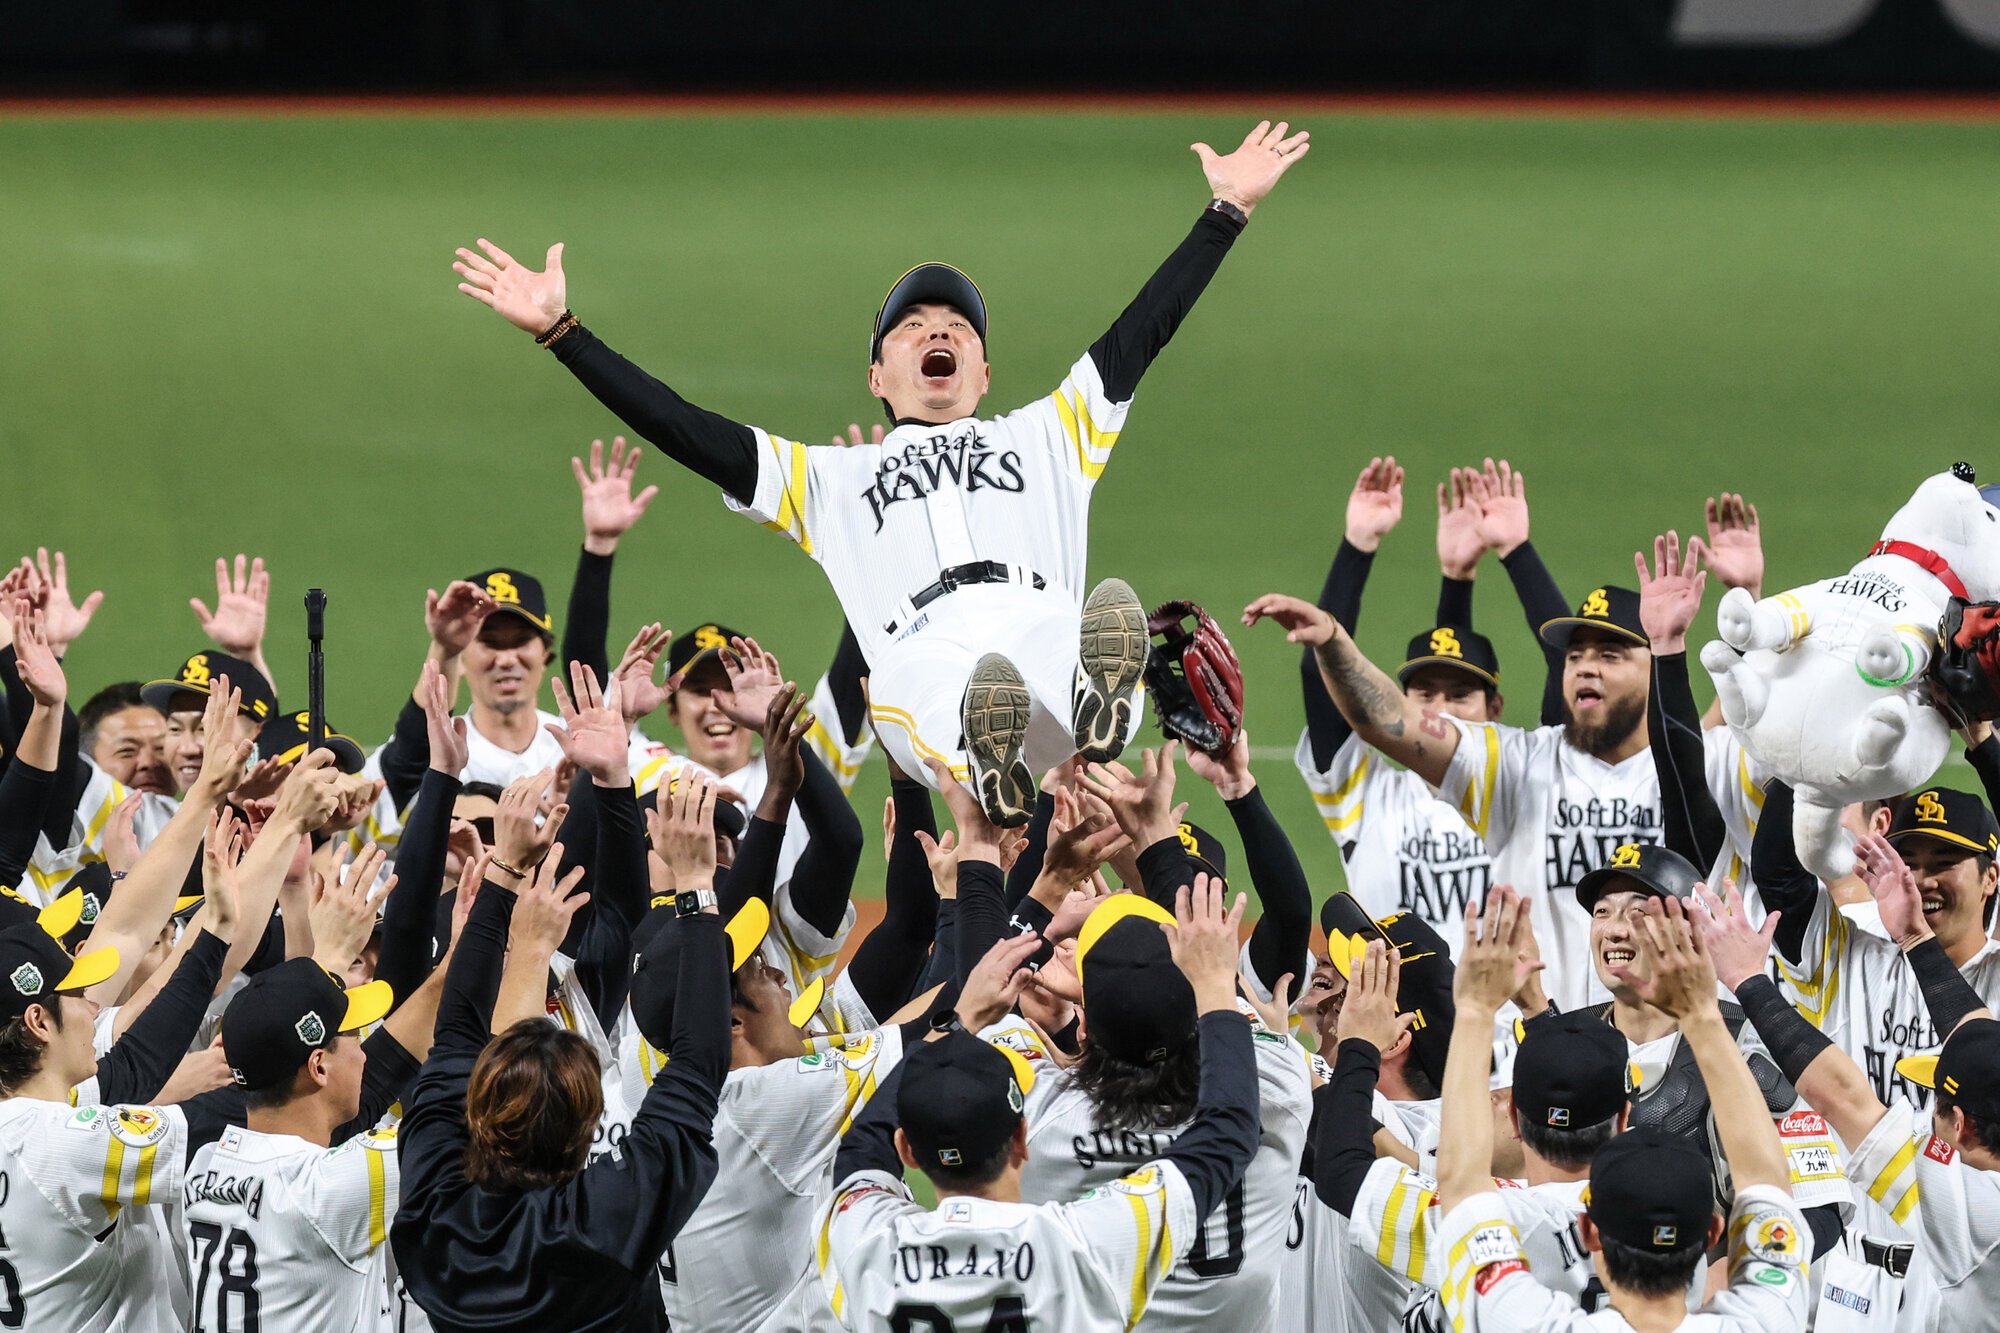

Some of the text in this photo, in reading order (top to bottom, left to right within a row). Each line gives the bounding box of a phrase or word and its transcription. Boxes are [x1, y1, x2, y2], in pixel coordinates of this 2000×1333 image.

[1825, 579, 1908, 613] HAWKS
[1881, 1008, 1941, 1050] SoftB
[1806, 1160, 1830, 1172] 九州
[188, 1220, 262, 1333] 78
